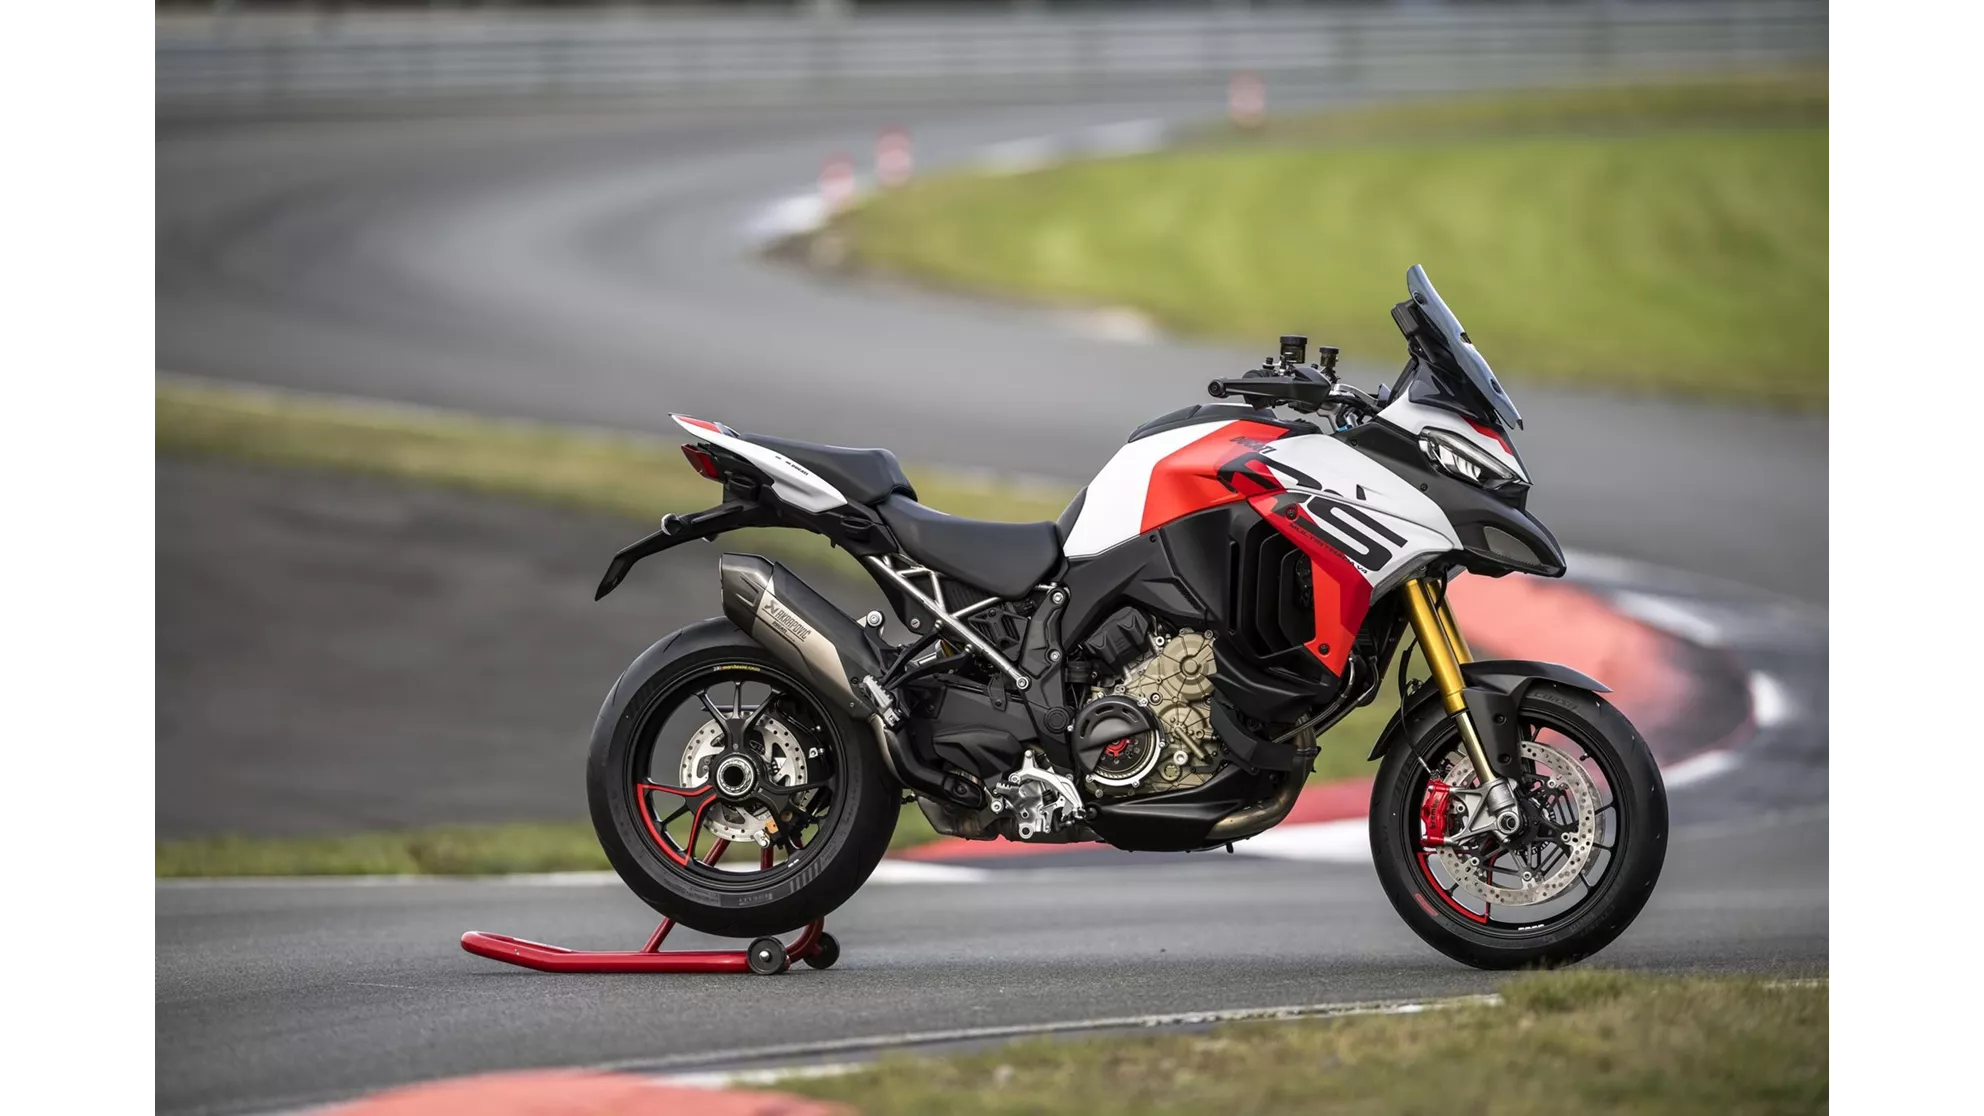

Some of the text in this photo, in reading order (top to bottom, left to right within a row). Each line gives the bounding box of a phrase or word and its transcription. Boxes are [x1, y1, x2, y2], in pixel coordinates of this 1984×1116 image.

[1229, 436, 1277, 454] DUCATI
[1289, 522, 1368, 574] MULTISTRADA V4
